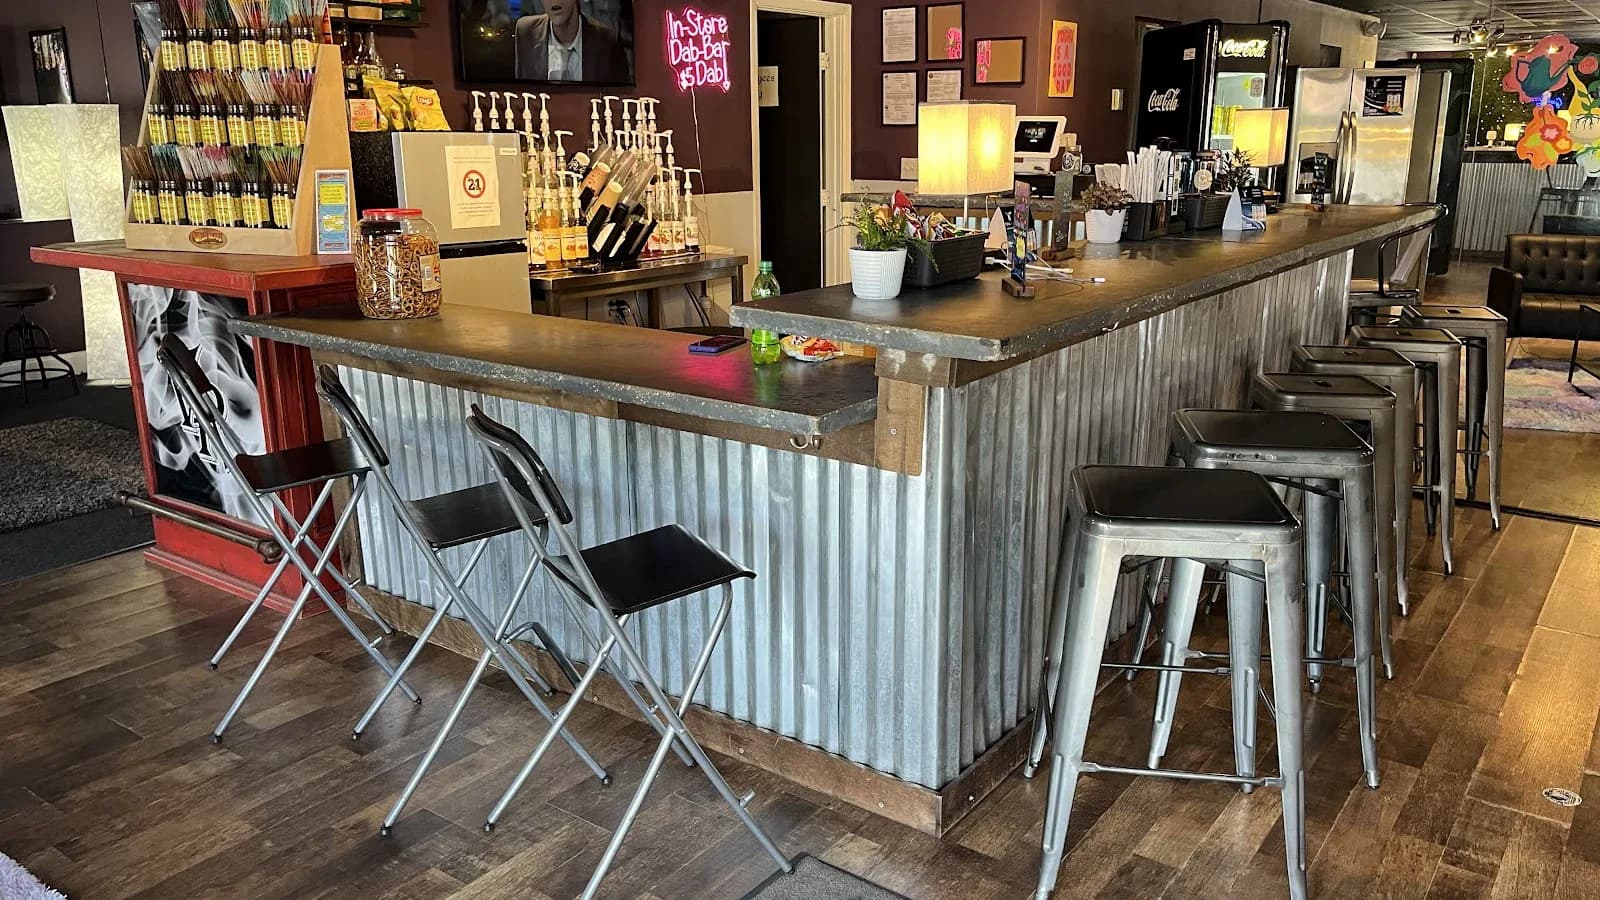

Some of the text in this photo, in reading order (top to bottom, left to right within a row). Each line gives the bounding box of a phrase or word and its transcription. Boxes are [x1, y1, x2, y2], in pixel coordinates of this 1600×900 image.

[668, 9, 729, 39] In-Store
[670, 34, 731, 65] Dab-Bar
[680, 58, 731, 91] $5 Dab!
[1053, 62, 1073, 78] GOOD
[467, 178, 482, 191] 21
